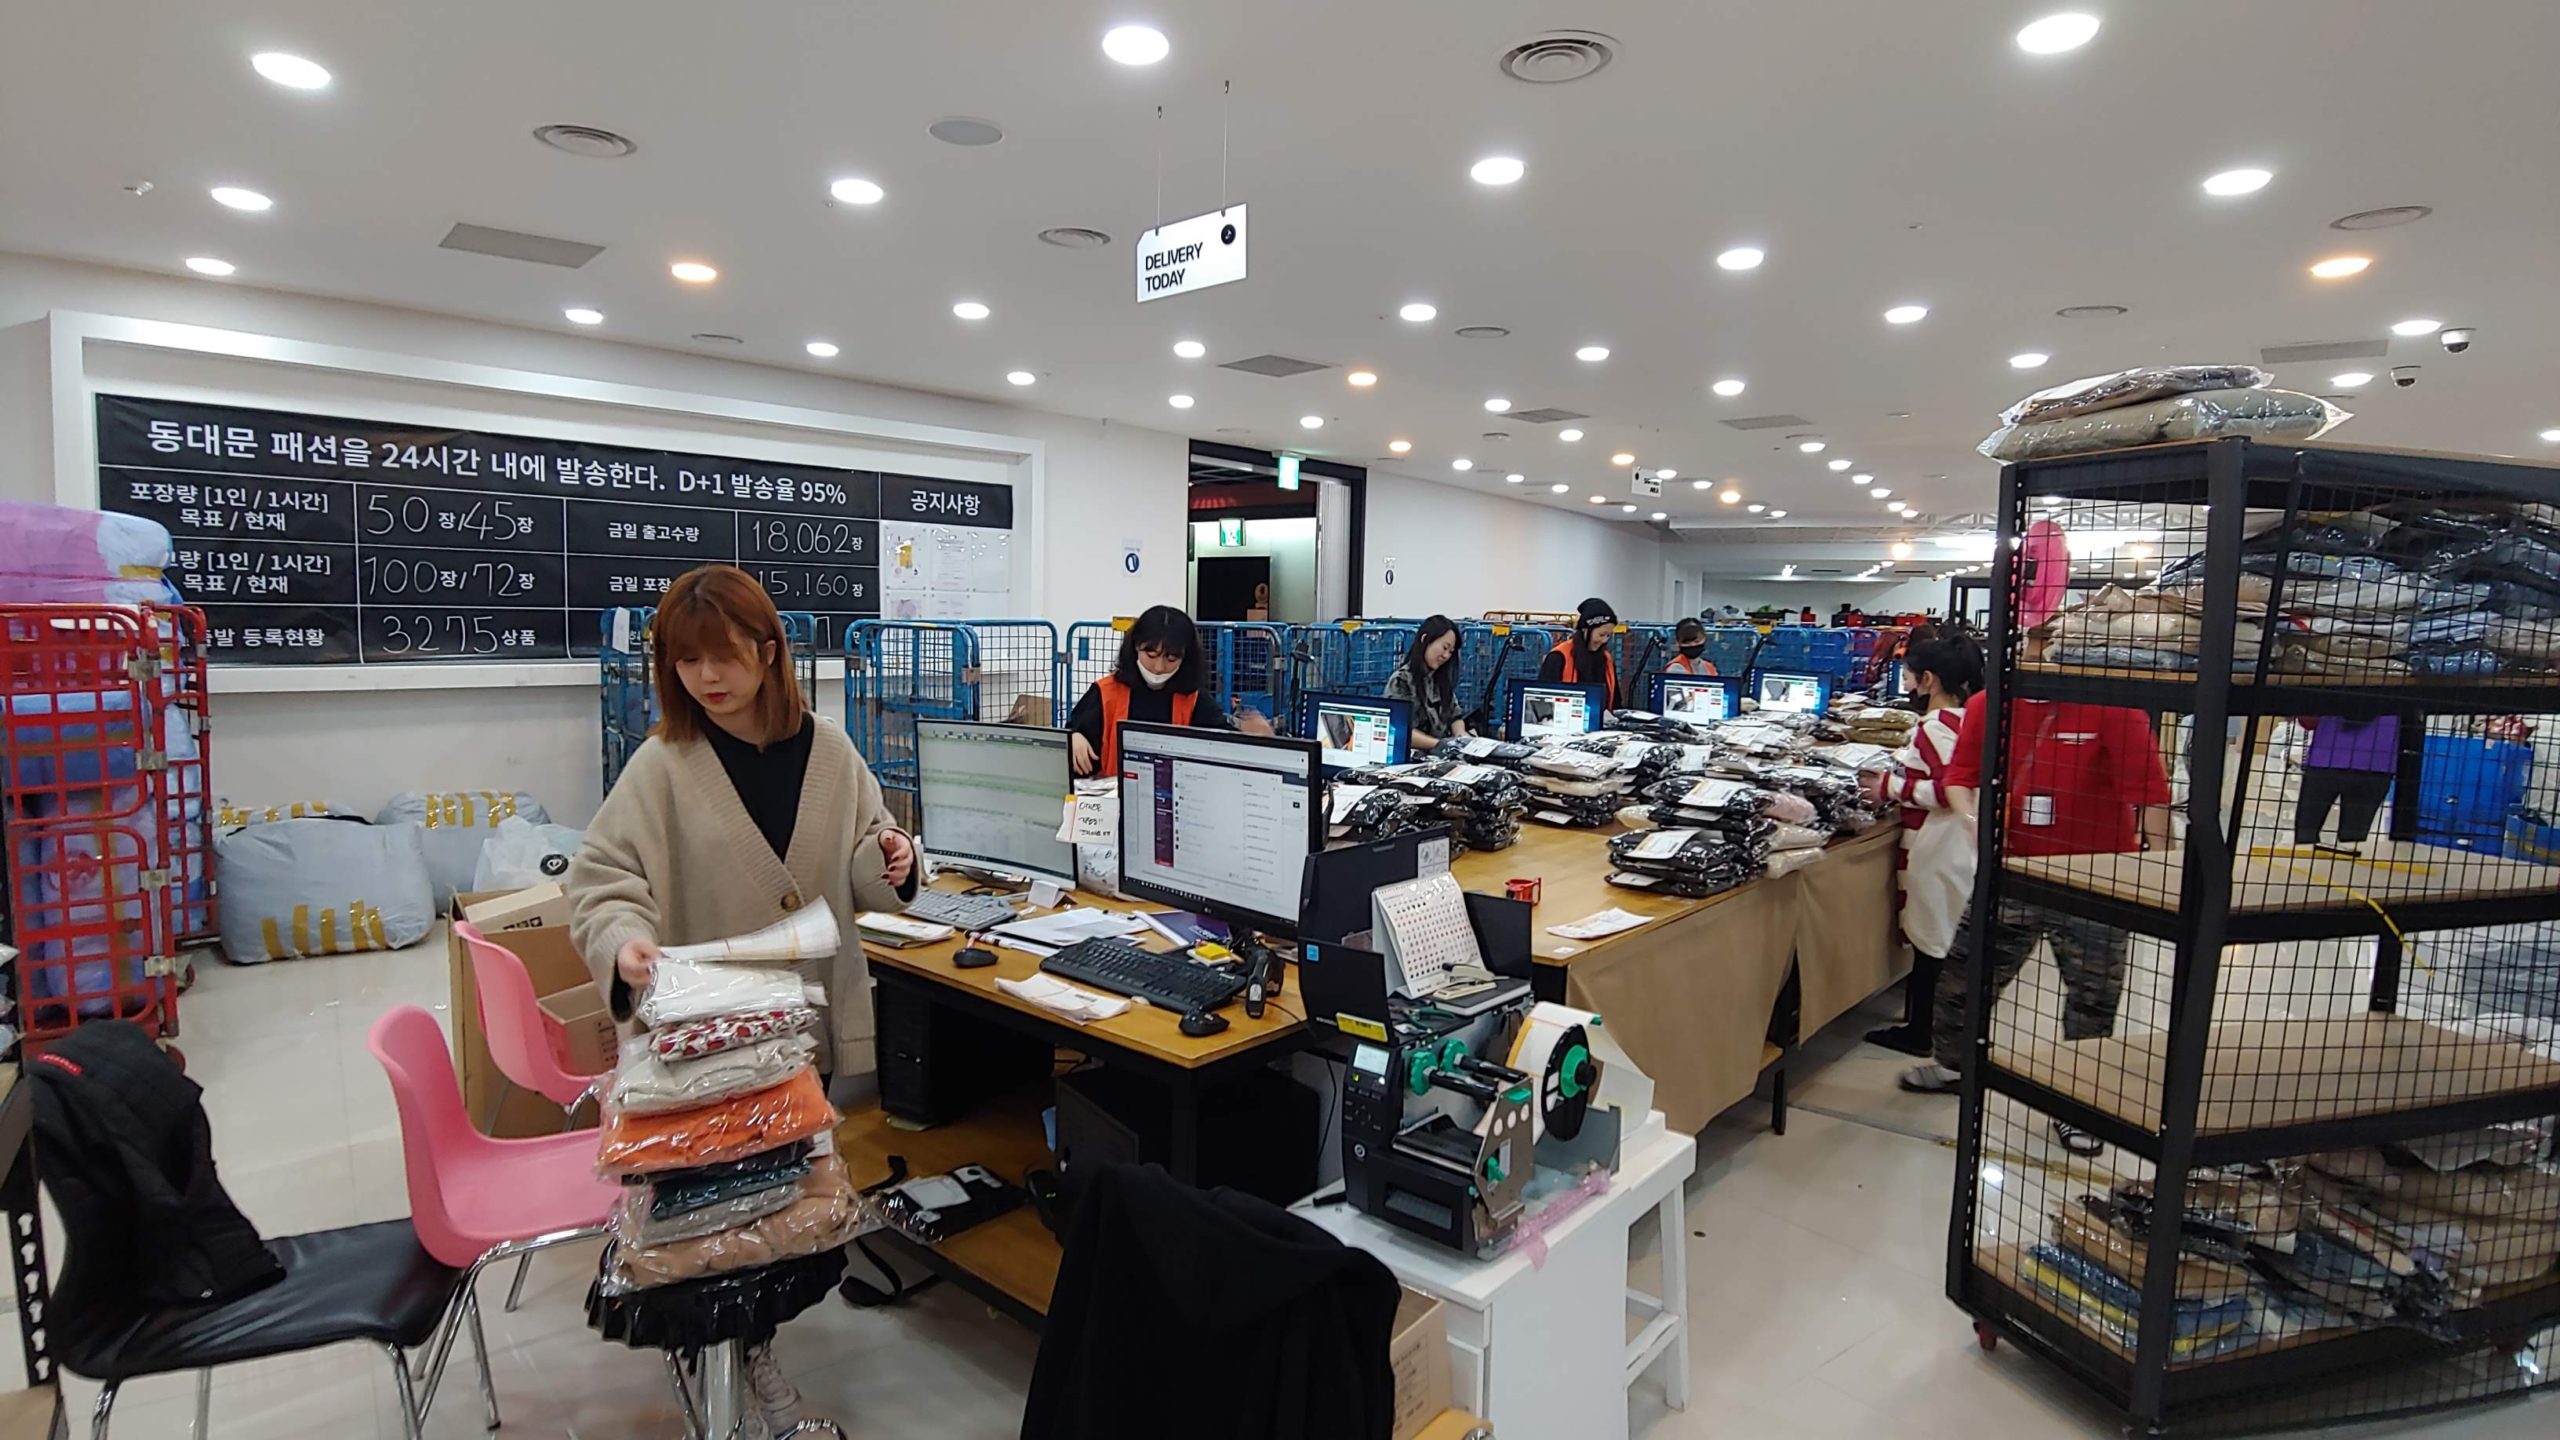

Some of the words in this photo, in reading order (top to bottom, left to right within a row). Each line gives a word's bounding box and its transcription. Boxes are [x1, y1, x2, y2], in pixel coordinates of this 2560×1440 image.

[1145, 242, 1203, 271] DELIVERY
[1145, 268, 1185, 292] TODAY
[147, 420, 258, 459] 동대문
[271, 431, 373, 468] 패션을
[381, 443, 481, 477] 24시간
[491, 452, 546, 483] 내에
[556, 457, 667, 492] 발송한다.
[679, 470, 725, 495] D+1
[731, 473, 796, 502] 발송율
[801, 481, 847, 505] 95%
[131, 482, 199, 504] 포장량
[267, 491, 329, 514] 1시간]
[910, 489, 981, 516] 공지사항
[180, 508, 225, 529] 목표
[244, 511, 287, 532] 현재
[608, 522, 638, 540] 금일
[642, 524, 700, 543] 출고수량
[271, 554, 331, 576] 1시간]
[183, 573, 227, 593] 목표
[247, 575, 289, 595] 현재
[609, 576, 639, 593] 금일
[242, 628, 326, 648] 등록현황
